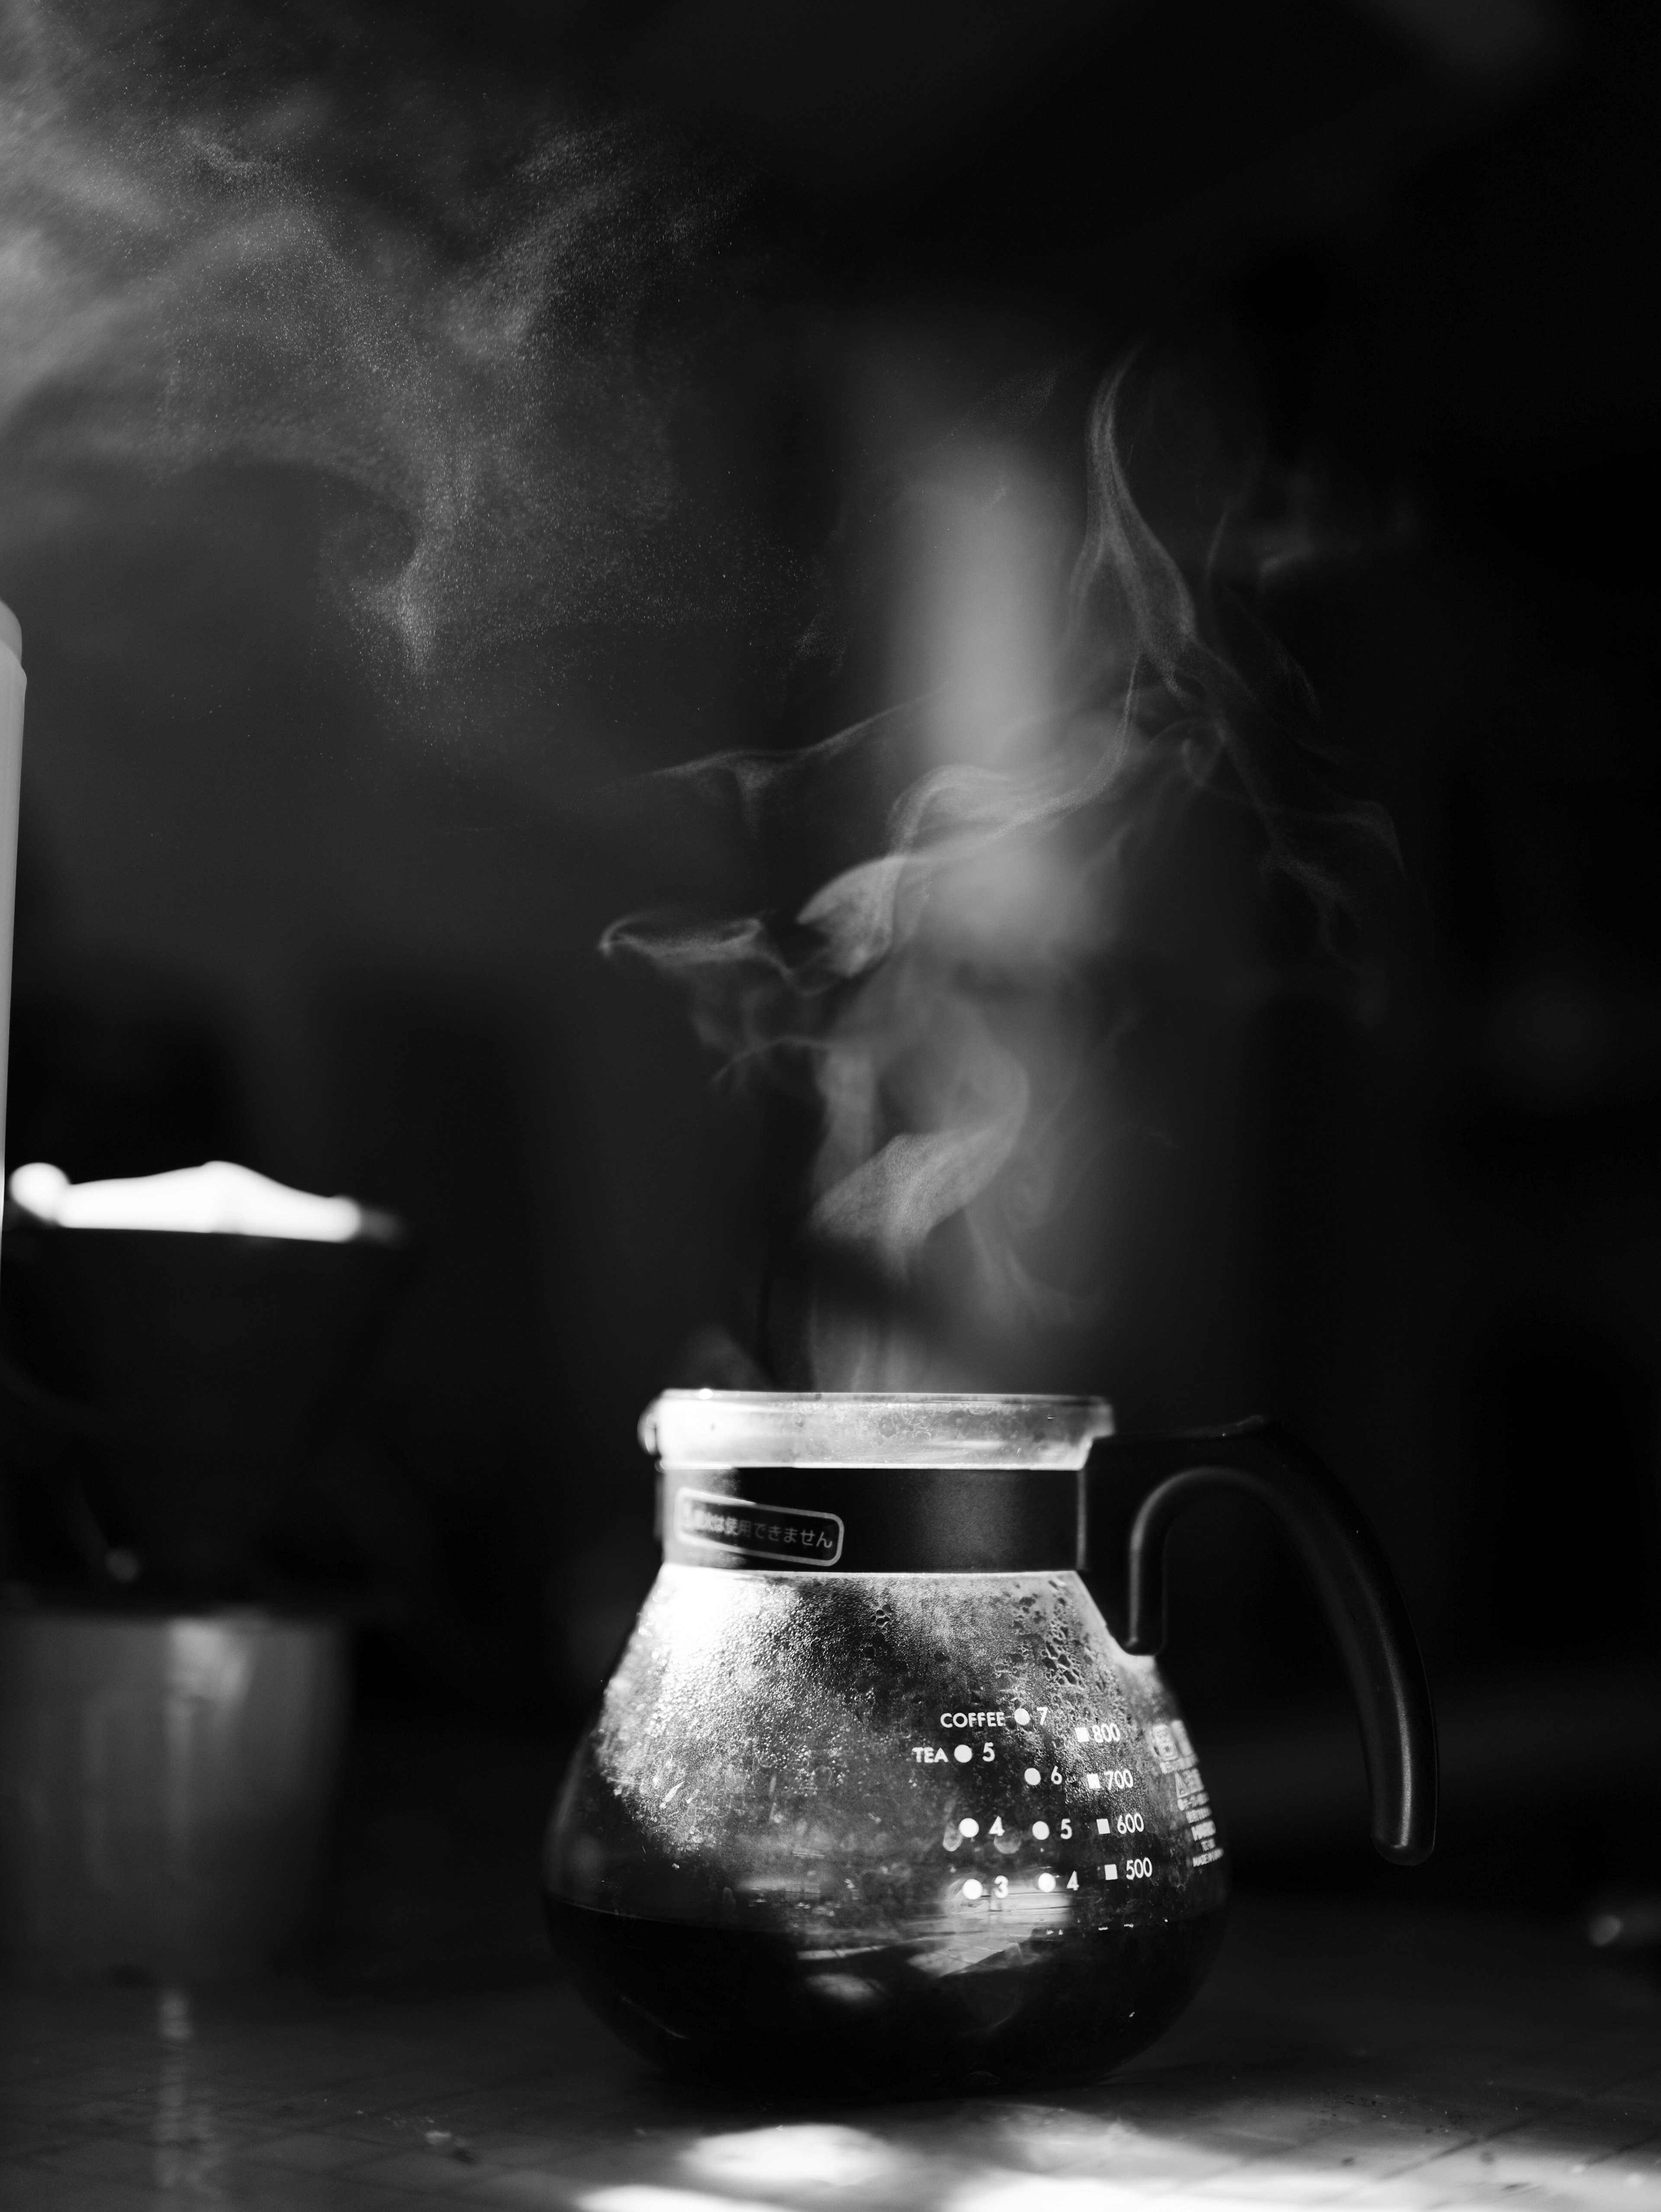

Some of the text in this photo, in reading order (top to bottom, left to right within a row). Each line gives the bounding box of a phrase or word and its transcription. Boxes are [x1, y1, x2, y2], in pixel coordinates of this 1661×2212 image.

[940, 1706, 1049, 1728] COFFEE 7
[1092, 1723, 1121, 1743] 800
[912, 1742, 995, 1763] TEA 5
[1051, 1766, 1062, 1784] 6
[1105, 1769, 1134, 1790] 700
[989, 1815, 1005, 1837] 4
[1061, 1818, 1072, 1839] 5
[1117, 1813, 1144, 1834] 600
[1126, 1857, 1152, 1880] 500
[993, 1875, 1009, 1899] 3
[1066, 1870, 1079, 1891] 4
